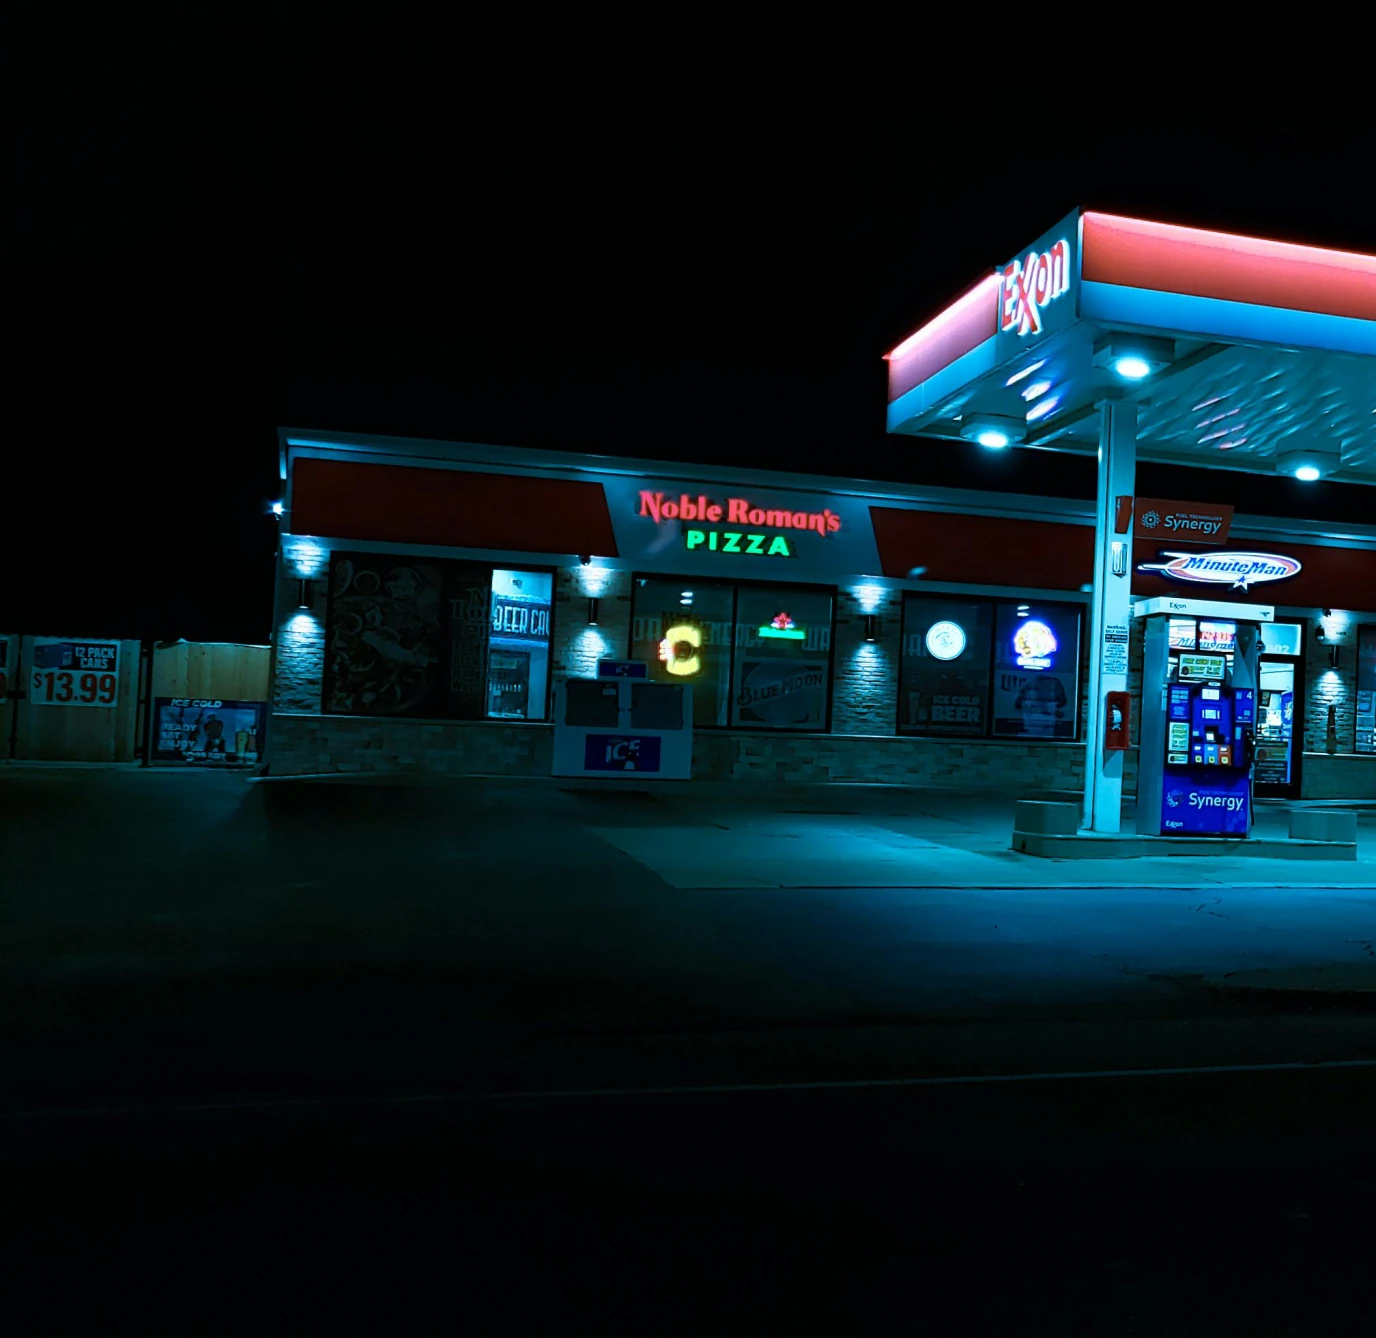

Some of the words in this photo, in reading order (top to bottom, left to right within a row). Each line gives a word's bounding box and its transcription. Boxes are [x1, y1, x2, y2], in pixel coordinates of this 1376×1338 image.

[638, 490, 723, 524] Noble
[727, 498, 841, 537] Roman's
[1163, 515, 1222, 535] Synergy
[687, 530, 790, 556] PIZZA
[492, 605, 529, 634] BEER
[75, 646, 85, 657] 12
[87, 647, 115, 659] PACK
[80, 657, 108, 669] CANS
[33, 672, 116, 704] $13.99
[1246, 691, 1252, 699] 4
[170, 699, 191, 707] ICE
[191, 699, 223, 708] COLD
[932, 694, 951, 704] ICE
[951, 695, 981, 706] COLD
[931, 704, 981, 722] BEER
[1189, 792, 1244, 811] Synergy
